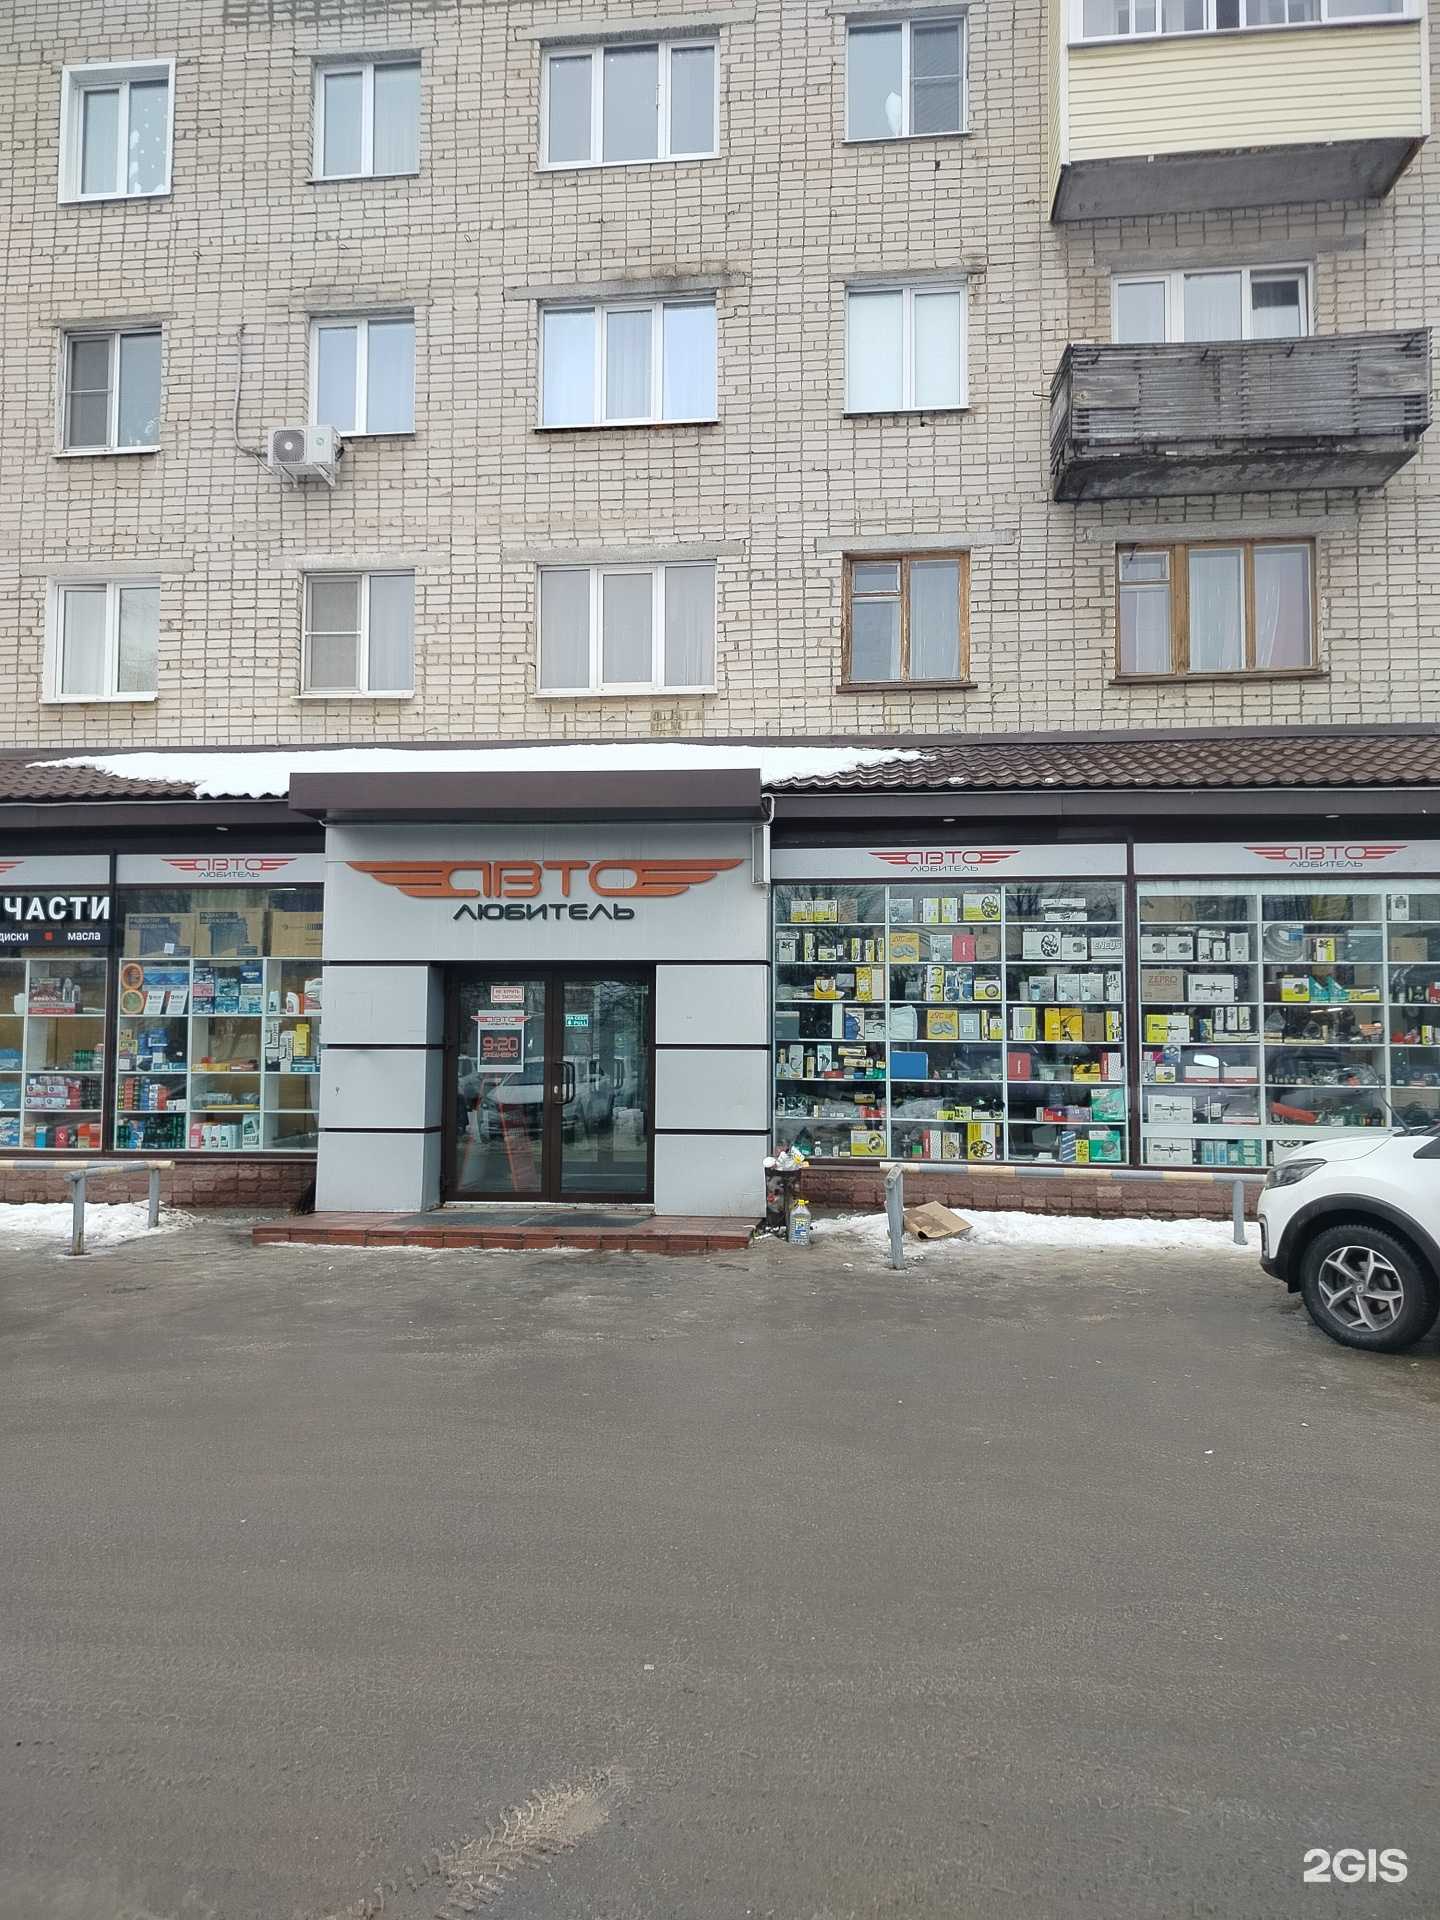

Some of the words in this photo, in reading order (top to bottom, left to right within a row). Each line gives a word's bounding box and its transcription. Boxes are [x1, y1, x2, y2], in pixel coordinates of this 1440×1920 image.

[905, 850, 982, 865] АВТО
[1283, 846, 1366, 860] АВТО
[194, 858, 262, 870] АВТО
[910, 865, 979, 873] ЛЮБИТЕЛЬ
[1288, 860, 1363, 868] ЛЮБИТЕЛЬ
[446, 860, 643, 898] АВТО
[4, 896, 110, 920] ЧАСТИ
[453, 903, 635, 921] ЛЮБИТЕЛЬ
[67, 932, 101, 940] масла
[483, 1037, 519, 1051] 9-20
